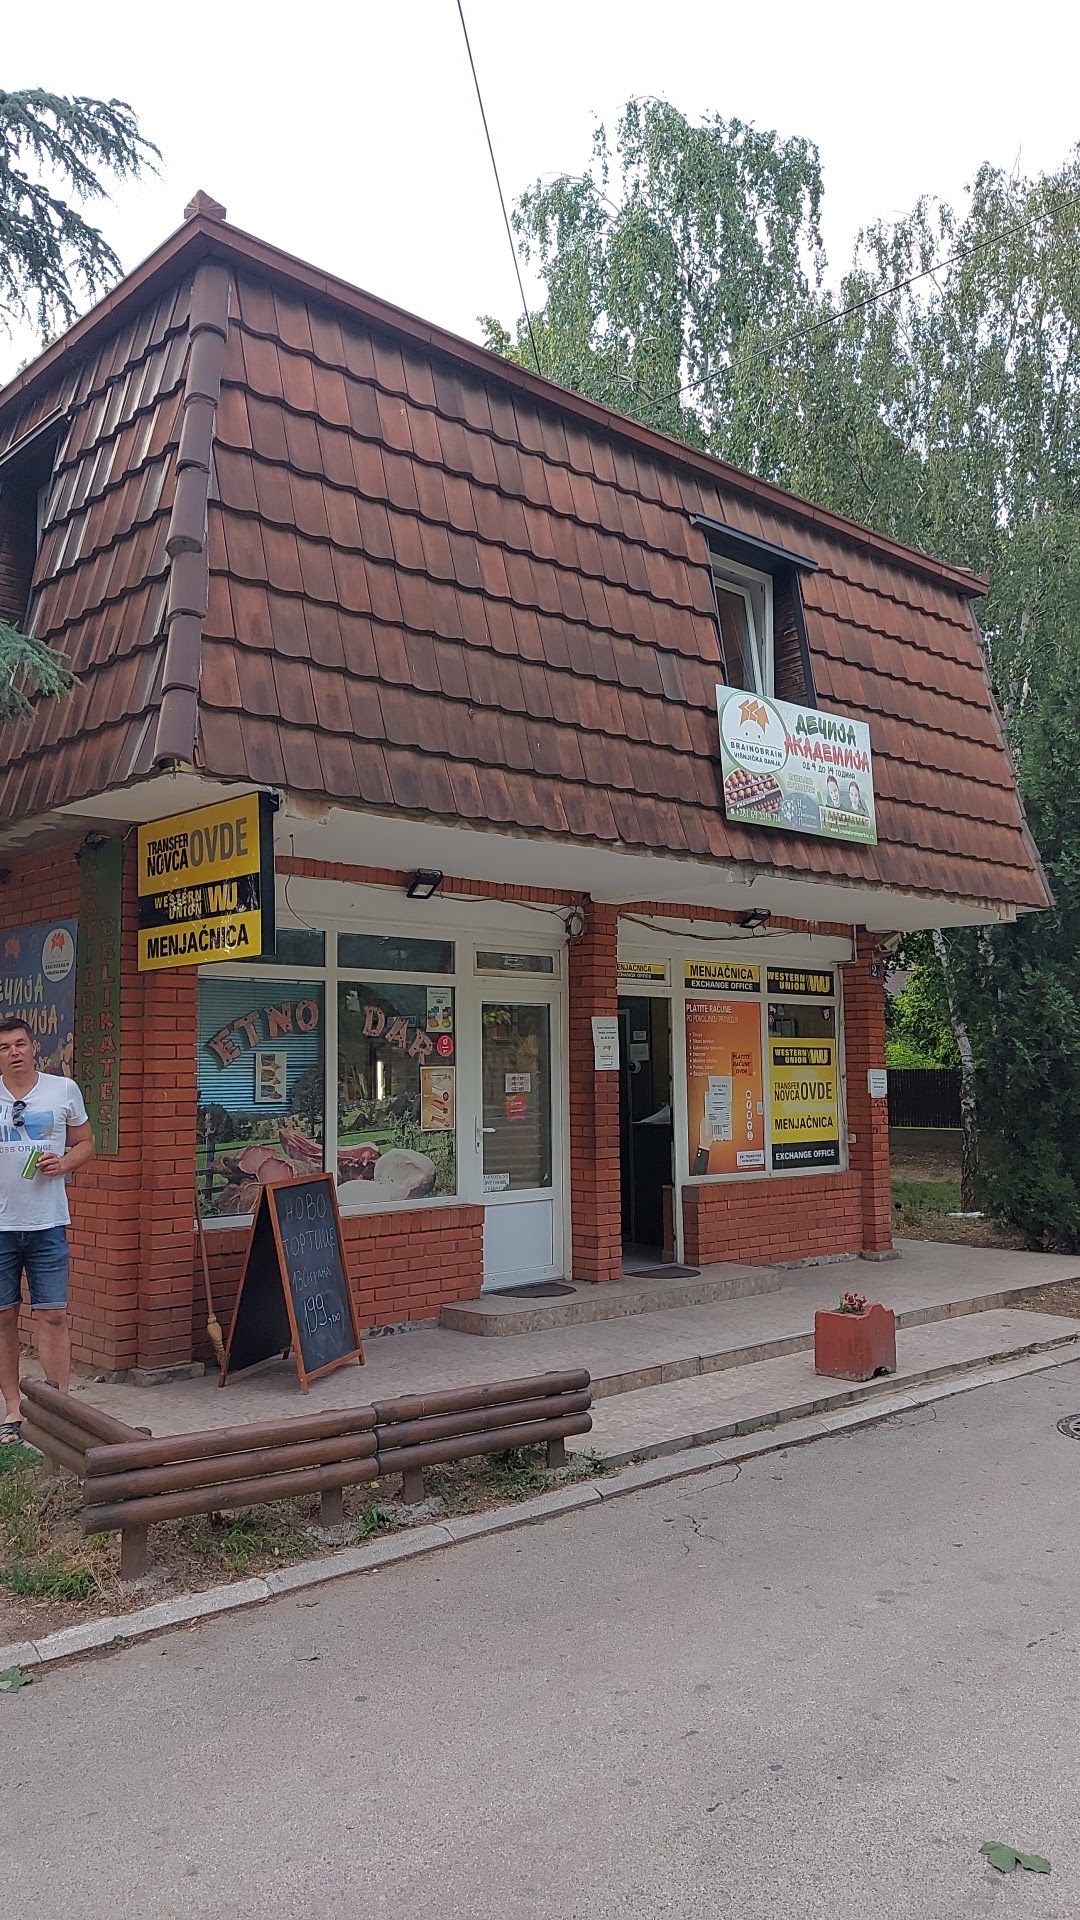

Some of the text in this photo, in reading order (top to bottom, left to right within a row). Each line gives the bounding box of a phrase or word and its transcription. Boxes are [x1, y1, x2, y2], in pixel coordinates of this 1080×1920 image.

[795, 713, 857, 747] ДЕЧИЈА
[730, 741, 783, 759] BRAINOBRAIN
[784, 732, 870, 773] АКАДЕМИЈА
[811, 763, 816, 771] 4
[828, 766, 834, 776] 14
[147, 833, 188, 856] TRANSFER
[147, 817, 248, 877] NOVCA OVDE
[154, 889, 202, 910] WESTERN
[168, 902, 202, 920] UNION
[690, 965, 753, 980] MENJAČNICA
[767, 972, 805, 982] WESTERN
[692, 980, 729, 989] EXCHANGE
[779, 982, 805, 991] UNION
[686, 1004, 708, 1013] PLATITE
[207, 999, 433, 1068] ETNO DAR
[785, 1056, 807, 1064] UNION
[775, 1082, 832, 1101] NOVCA OVDE
[775, 1115, 833, 1130] MENJAČNICA
[776, 1149, 835, 1161] EXCHANGE OFFICE
